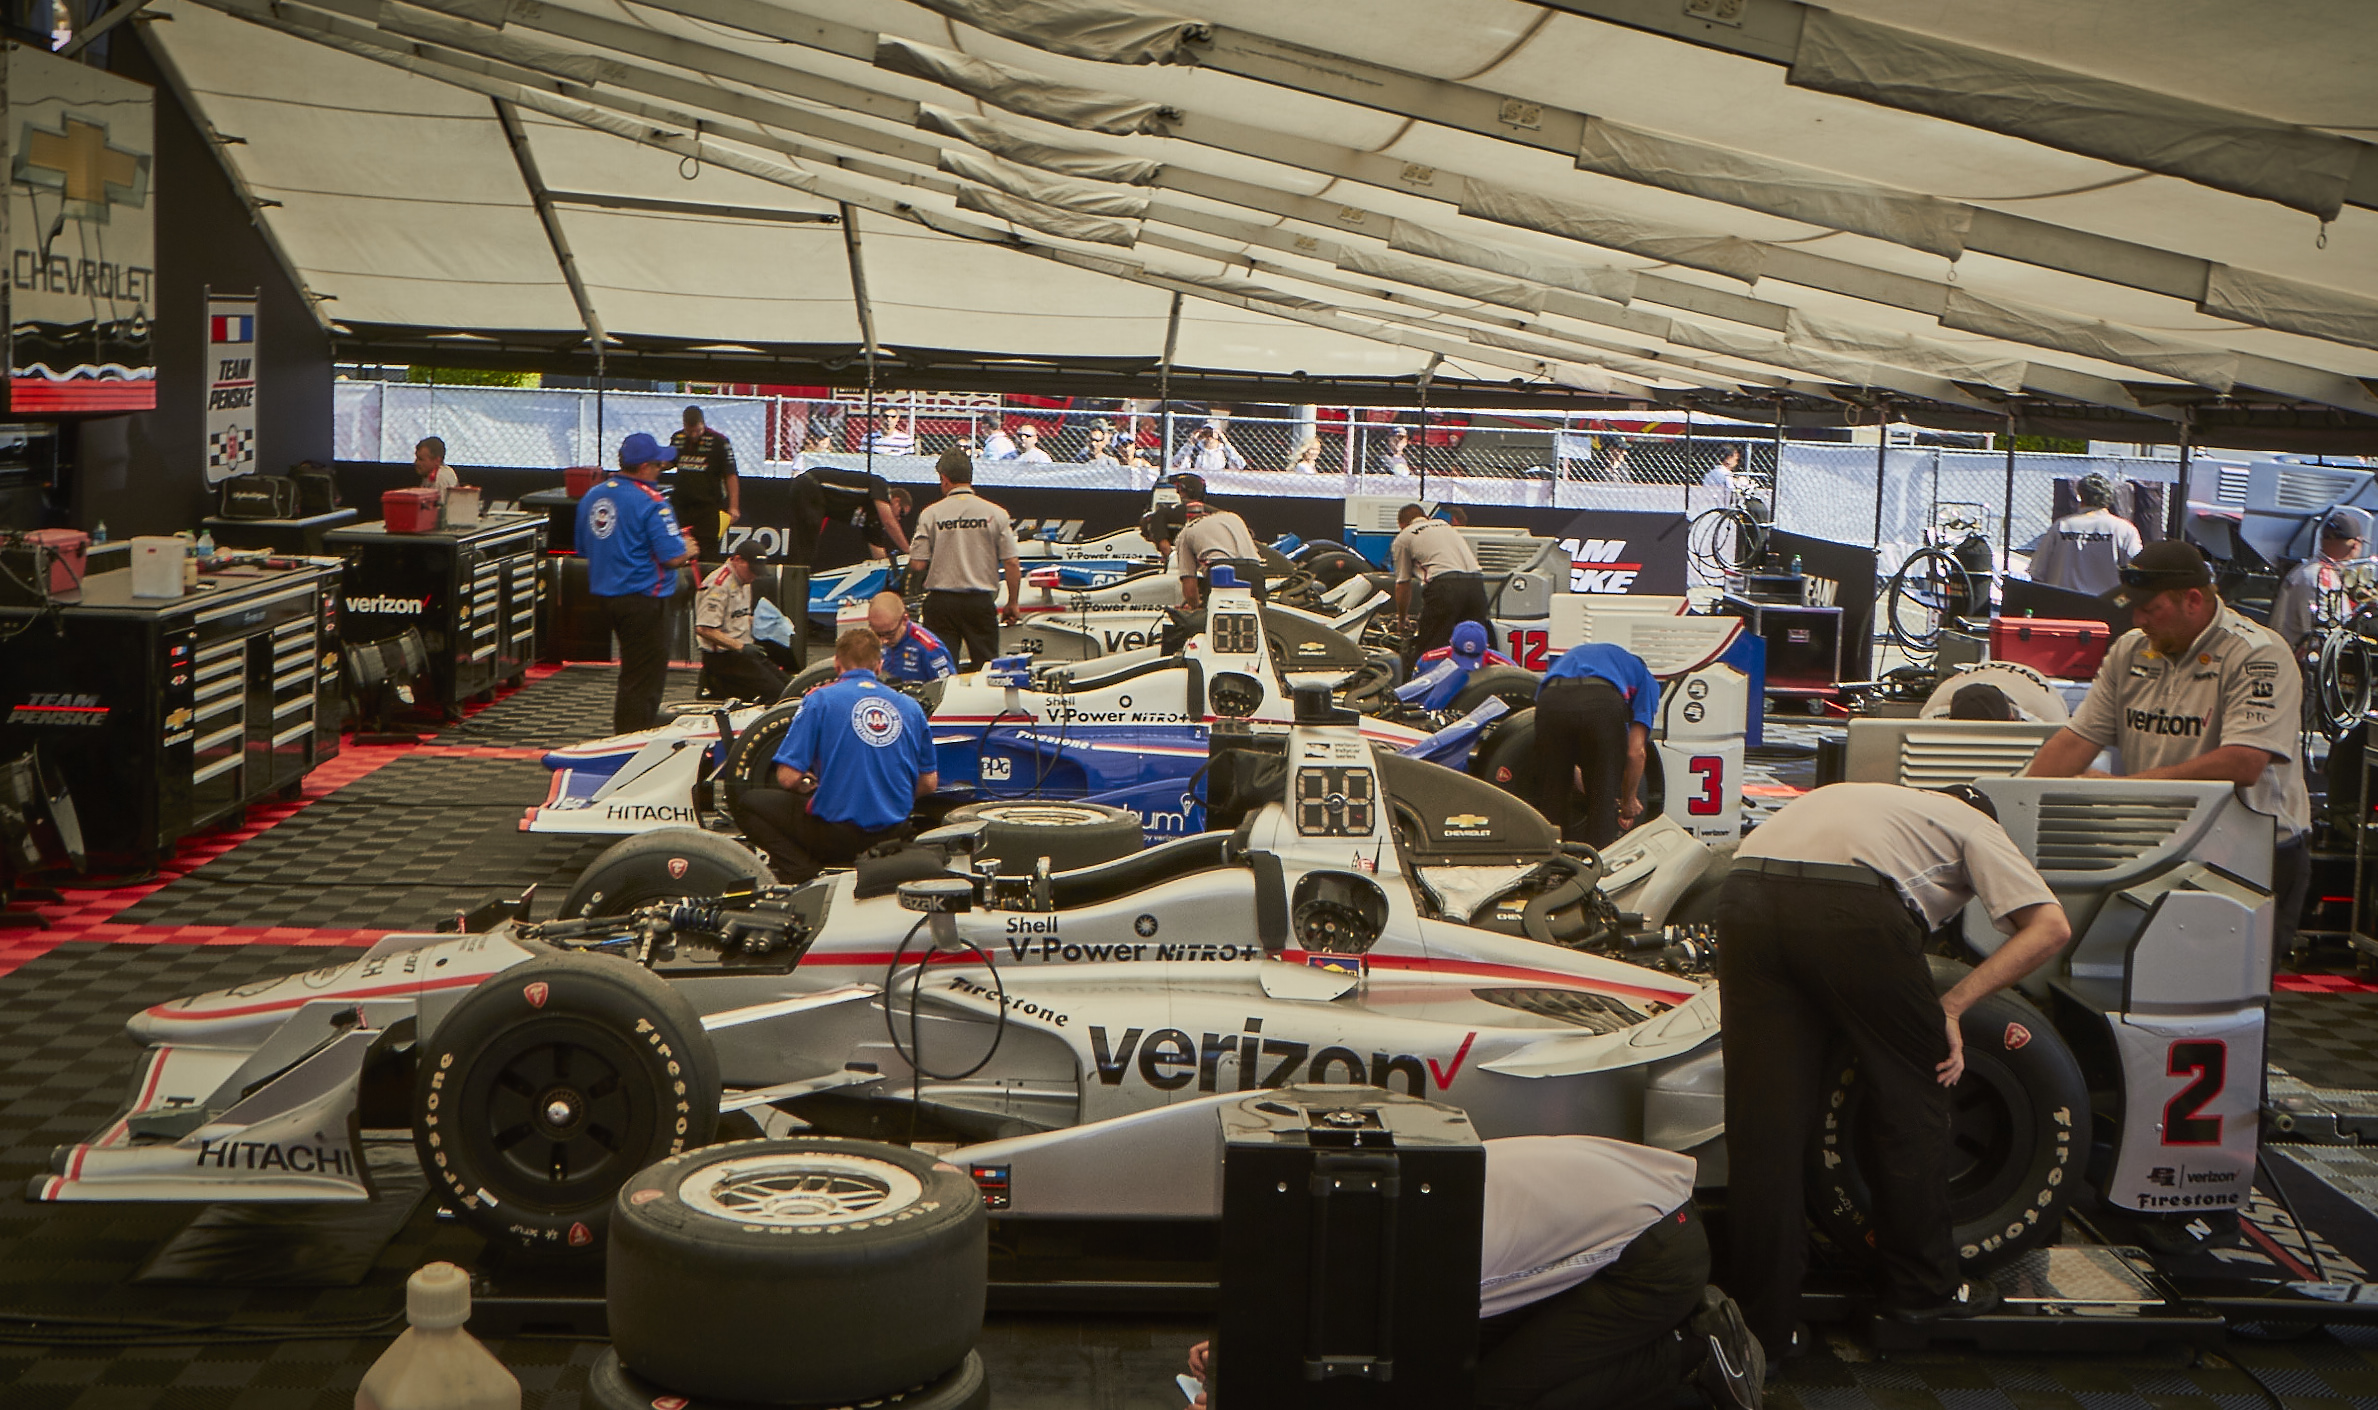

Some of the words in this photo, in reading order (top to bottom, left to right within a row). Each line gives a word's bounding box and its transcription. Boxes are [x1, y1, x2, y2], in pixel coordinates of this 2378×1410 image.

[13, 248, 153, 303] CHEVROLET
[219, 358, 252, 381] TEAM
[208, 386, 254, 411] PENSKE
[936, 516, 987, 531] verizon
[719, 526, 791, 557] IZO
[1066, 552, 1109, 560] V-Power
[345, 595, 422, 614] verizon
[1070, 602, 1126, 612] V-Power
[1507, 630, 1549, 672] 12
[27, 693, 97, 708] TEAM
[1046, 696, 1076, 708] Shell
[7, 710, 106, 726] PENSKE
[1046, 708, 1126, 723] V-Power
[2126, 706, 2201, 737] verizon
[1015, 729, 1092, 750] Firestone
[1688, 756, 1724, 816] 3
[607, 804, 696, 823] HITACHI
[1005, 915, 1059, 934] Shell
[1006, 936, 1148, 963] V-Power
[949, 975, 1069, 1028] Firestone
[1088, 1016, 1428, 1099] verizon
[2160, 1038, 2228, 1147] 2
[196, 1137, 355, 1177] HITACHI
[1960, 1105, 2073, 1260] Firestone
[2187, 1171, 2236, 1184] verizon
[2137, 1191, 2240, 1210] Firestone
